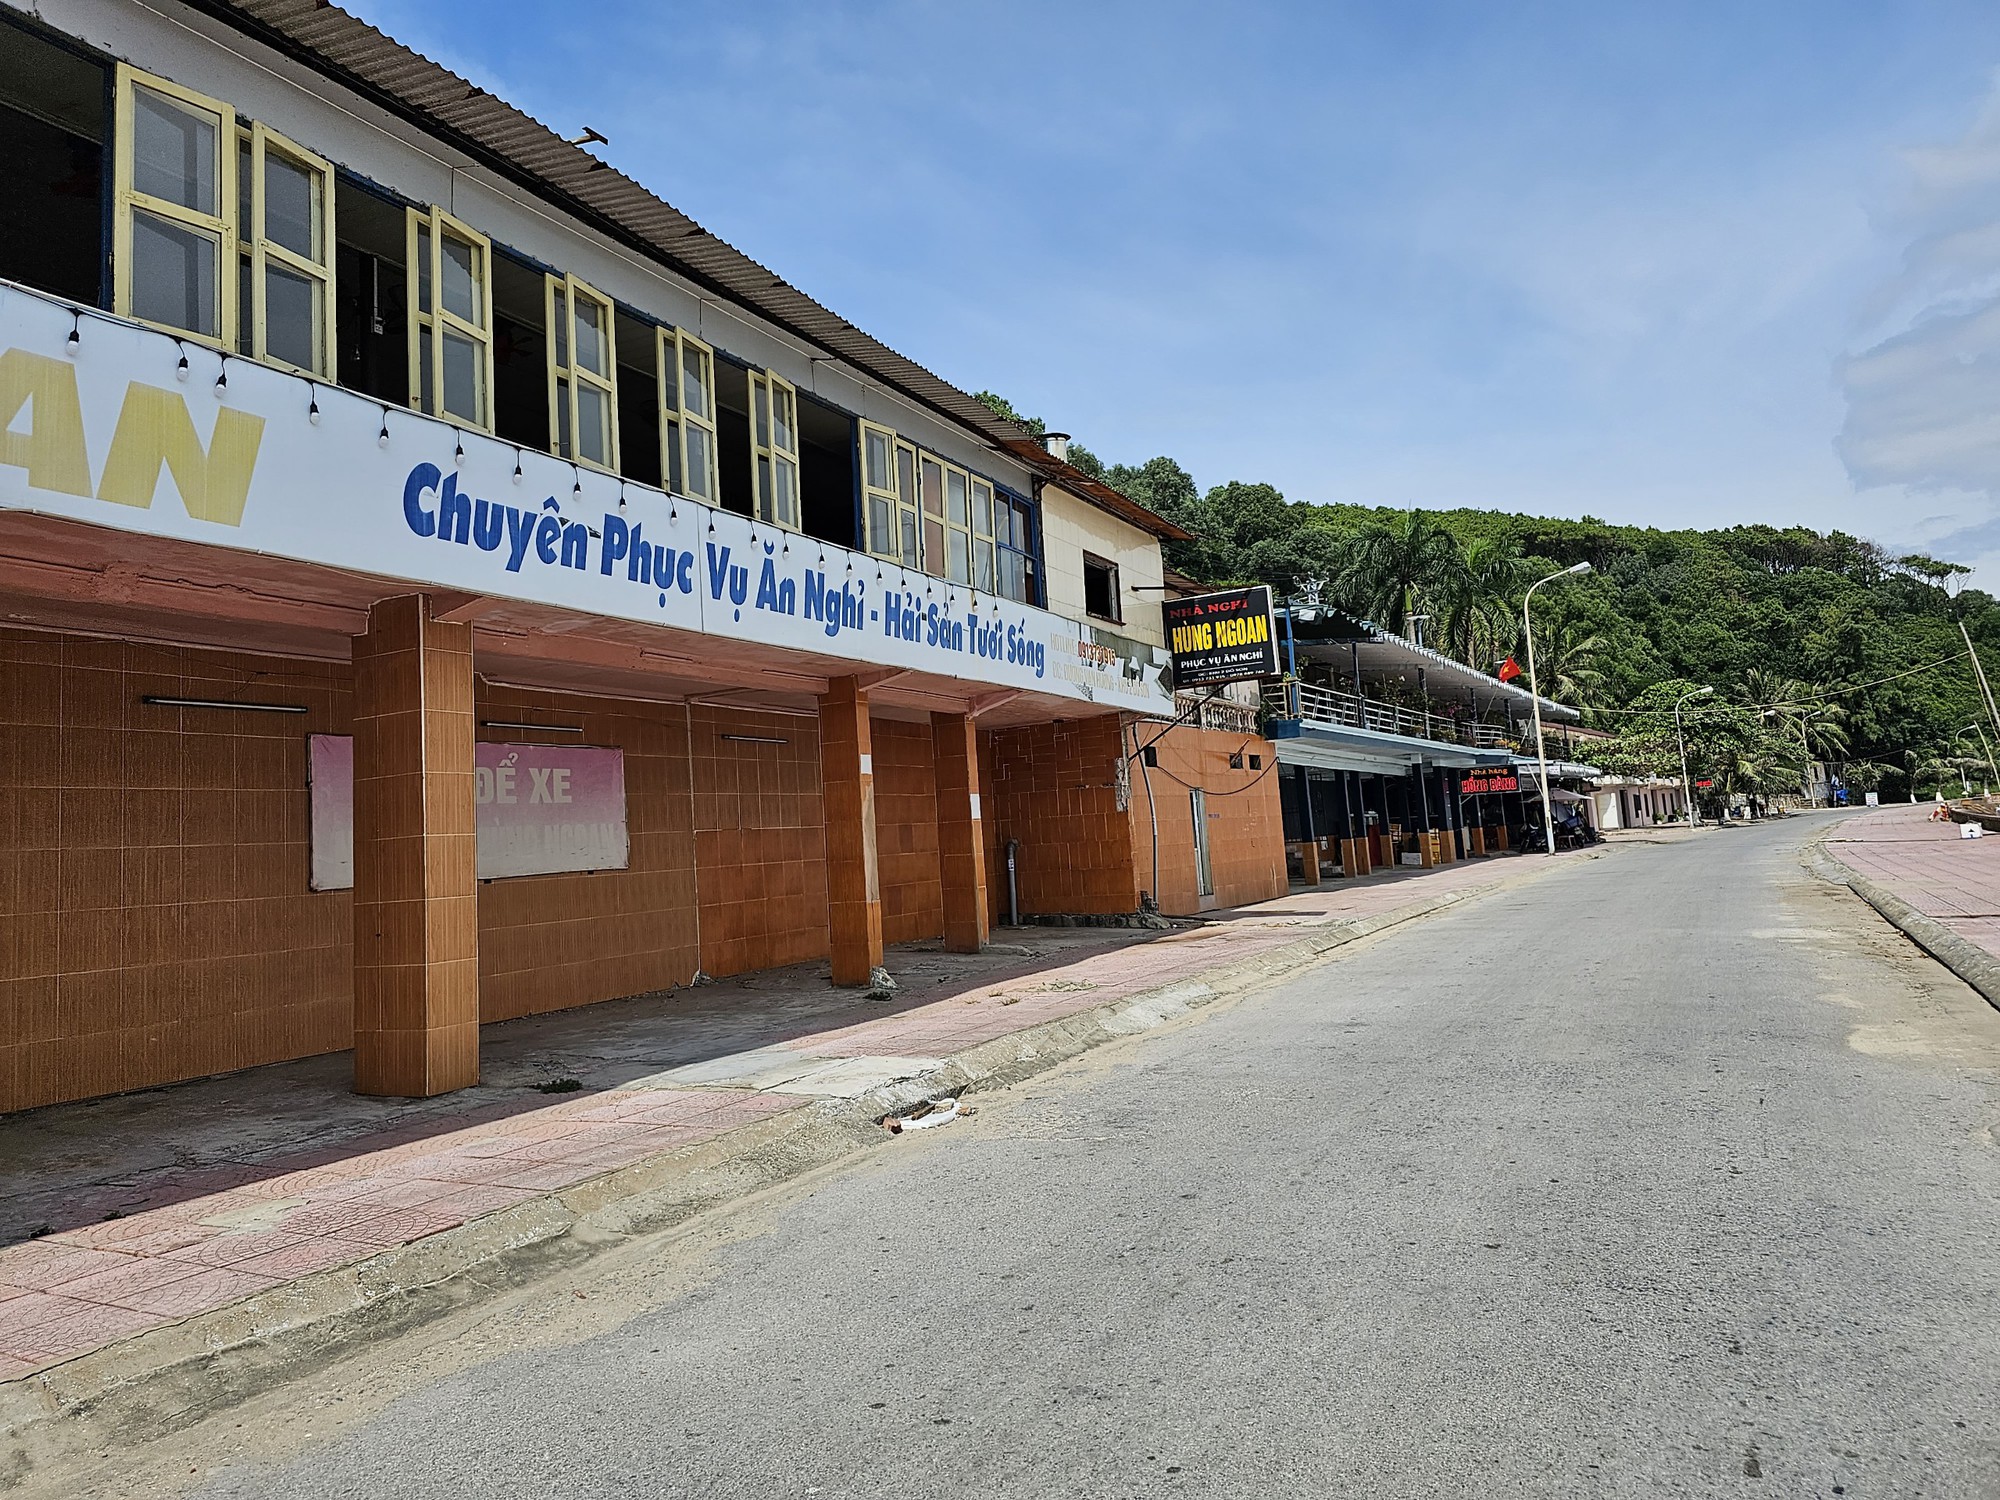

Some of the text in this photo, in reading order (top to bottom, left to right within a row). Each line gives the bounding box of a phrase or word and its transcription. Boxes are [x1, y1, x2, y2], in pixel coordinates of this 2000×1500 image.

[403, 462, 588, 573] Chuyên
[600, 513, 694, 608] Phục
[706, 542, 749, 623] Vụ
[755, 539, 796, 616] Ăn
[804, 568, 865, 637] Nghỉ
[885, 590, 922, 643] Hải
[927, 602, 963, 652] Sản
[968, 613, 1003, 660] Tươi
[1007, 617, 1045, 679] Sống
[1169, 604, 1204, 618] NHÀ
[1172, 614, 1268, 654] HÙNG NGOAN
[1181, 648, 1264, 669] PHỤC VỤ ĂN NGHỈ
[528, 768, 573, 805] XE
